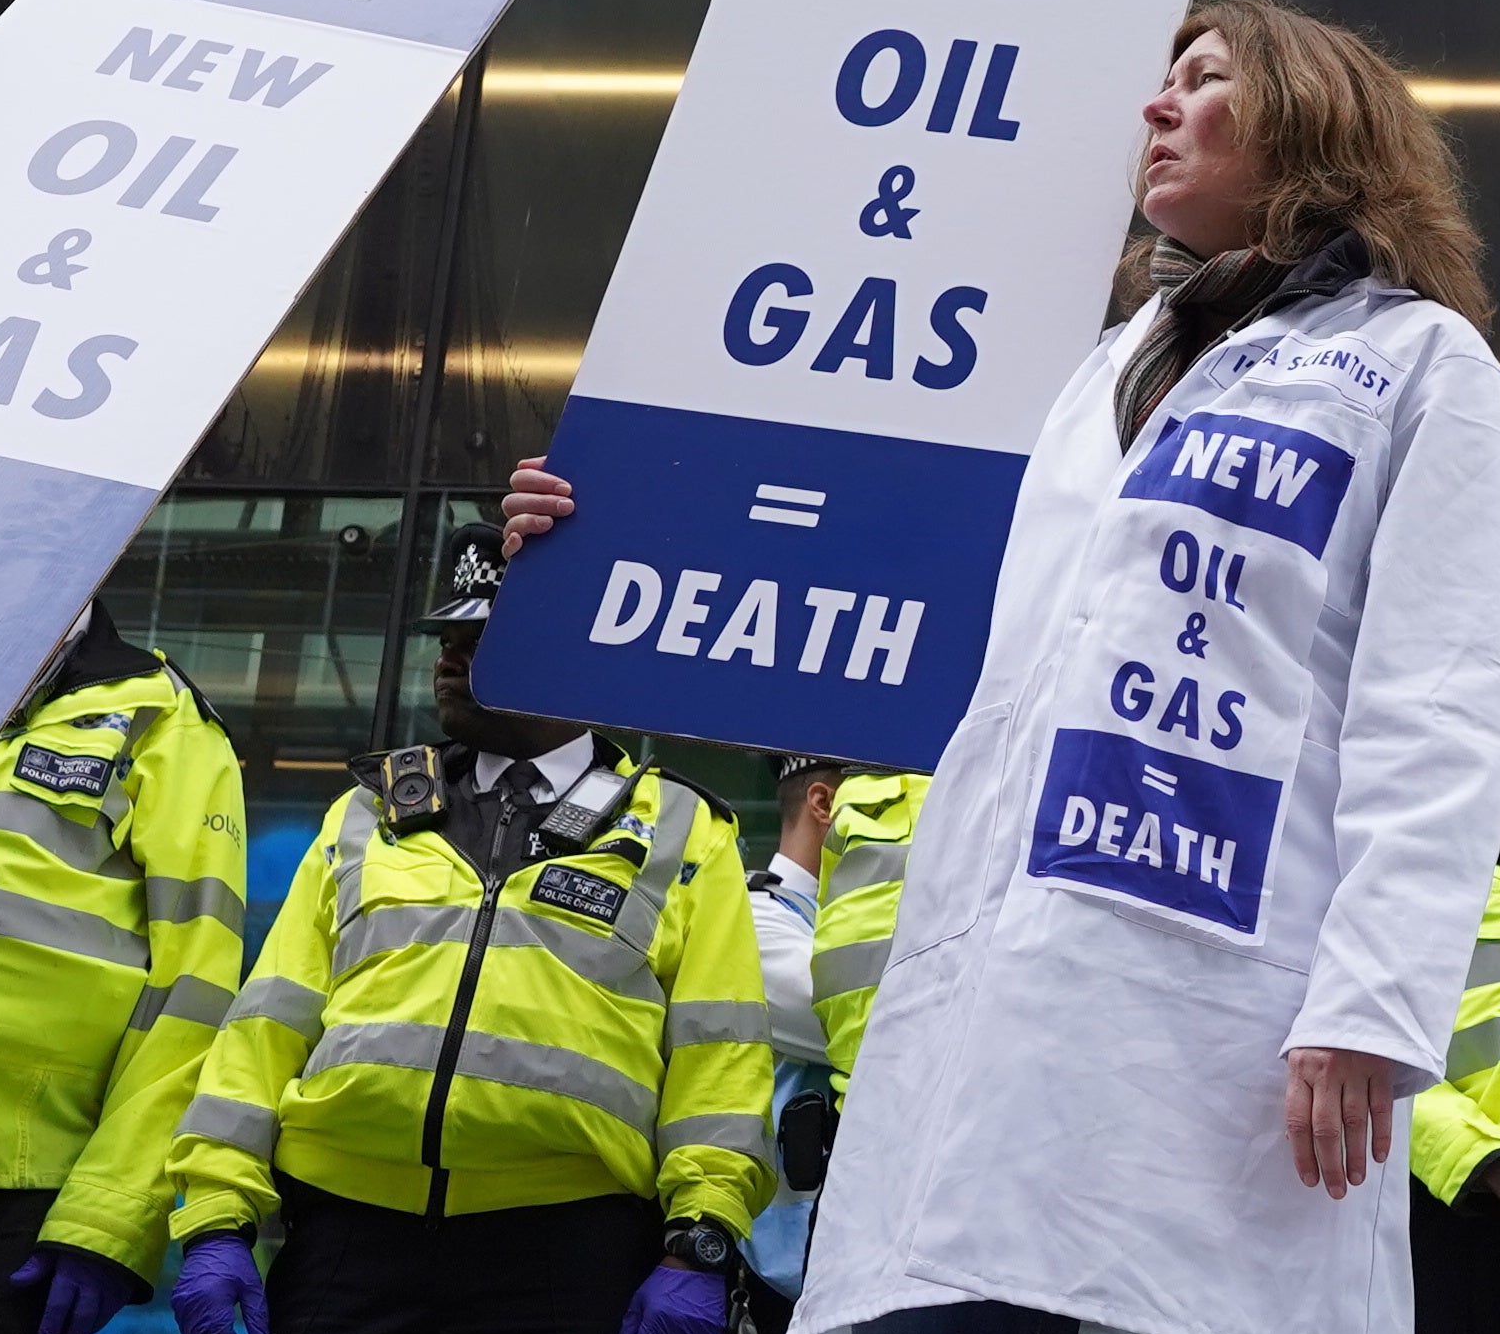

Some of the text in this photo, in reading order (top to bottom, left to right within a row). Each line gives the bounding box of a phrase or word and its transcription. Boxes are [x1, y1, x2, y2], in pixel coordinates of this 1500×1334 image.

[95, 25, 335, 110] NEW
[834, 28, 1021, 142] OIL
[25, 119, 240, 224] OIL
[859, 164, 921, 240] &
[16, 226, 94, 291] &
[722, 262, 989, 392] GAS
[1171, 429, 1320, 508] NEW
[1160, 529, 1246, 612] OIL
[588, 558, 926, 687] DEATH
[1177, 612, 1209, 659] &
[1110, 660, 1246, 751] GAS
[21, 766, 100, 791] POLICE OFFICER
[1058, 795, 1237, 893] DEATH
[538, 888, 613, 918] POLICE OFFICER
